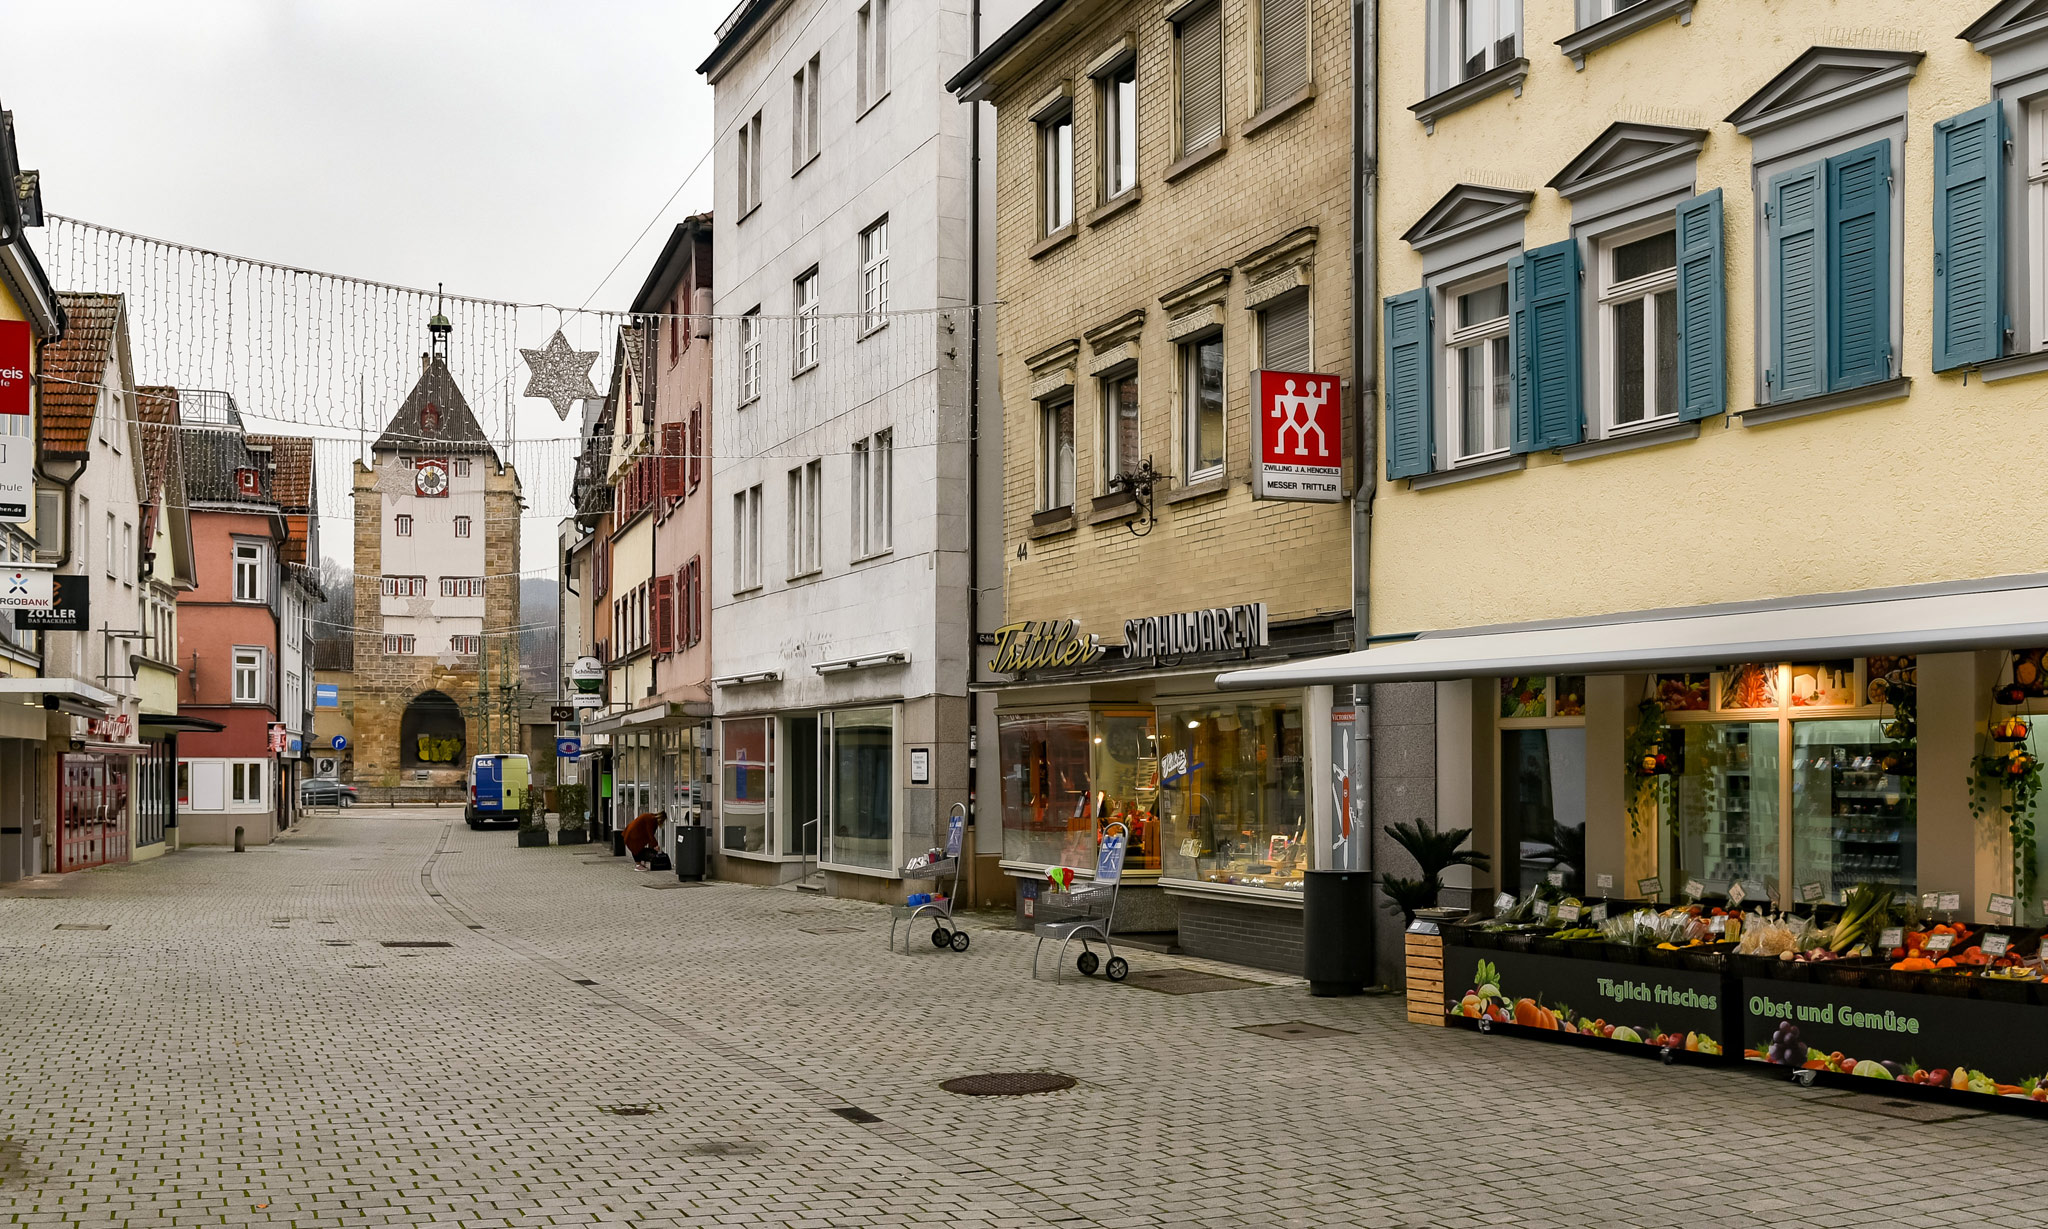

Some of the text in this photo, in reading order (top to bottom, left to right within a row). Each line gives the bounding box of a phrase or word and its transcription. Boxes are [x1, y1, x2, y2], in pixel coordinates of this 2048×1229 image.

[1263, 464, 1292, 472] ZWILLING
[1267, 481, 1337, 491] MESSER TRITTLER
[1016, 542, 1028, 561] 44
[988, 602, 1263, 673] Trittler STAHLWAREN
[1332, 713, 1355, 721] VICTORINO
[1597, 978, 1717, 1010] Täglich frisches
[1749, 996, 1919, 1034] Obst und Gemüse
